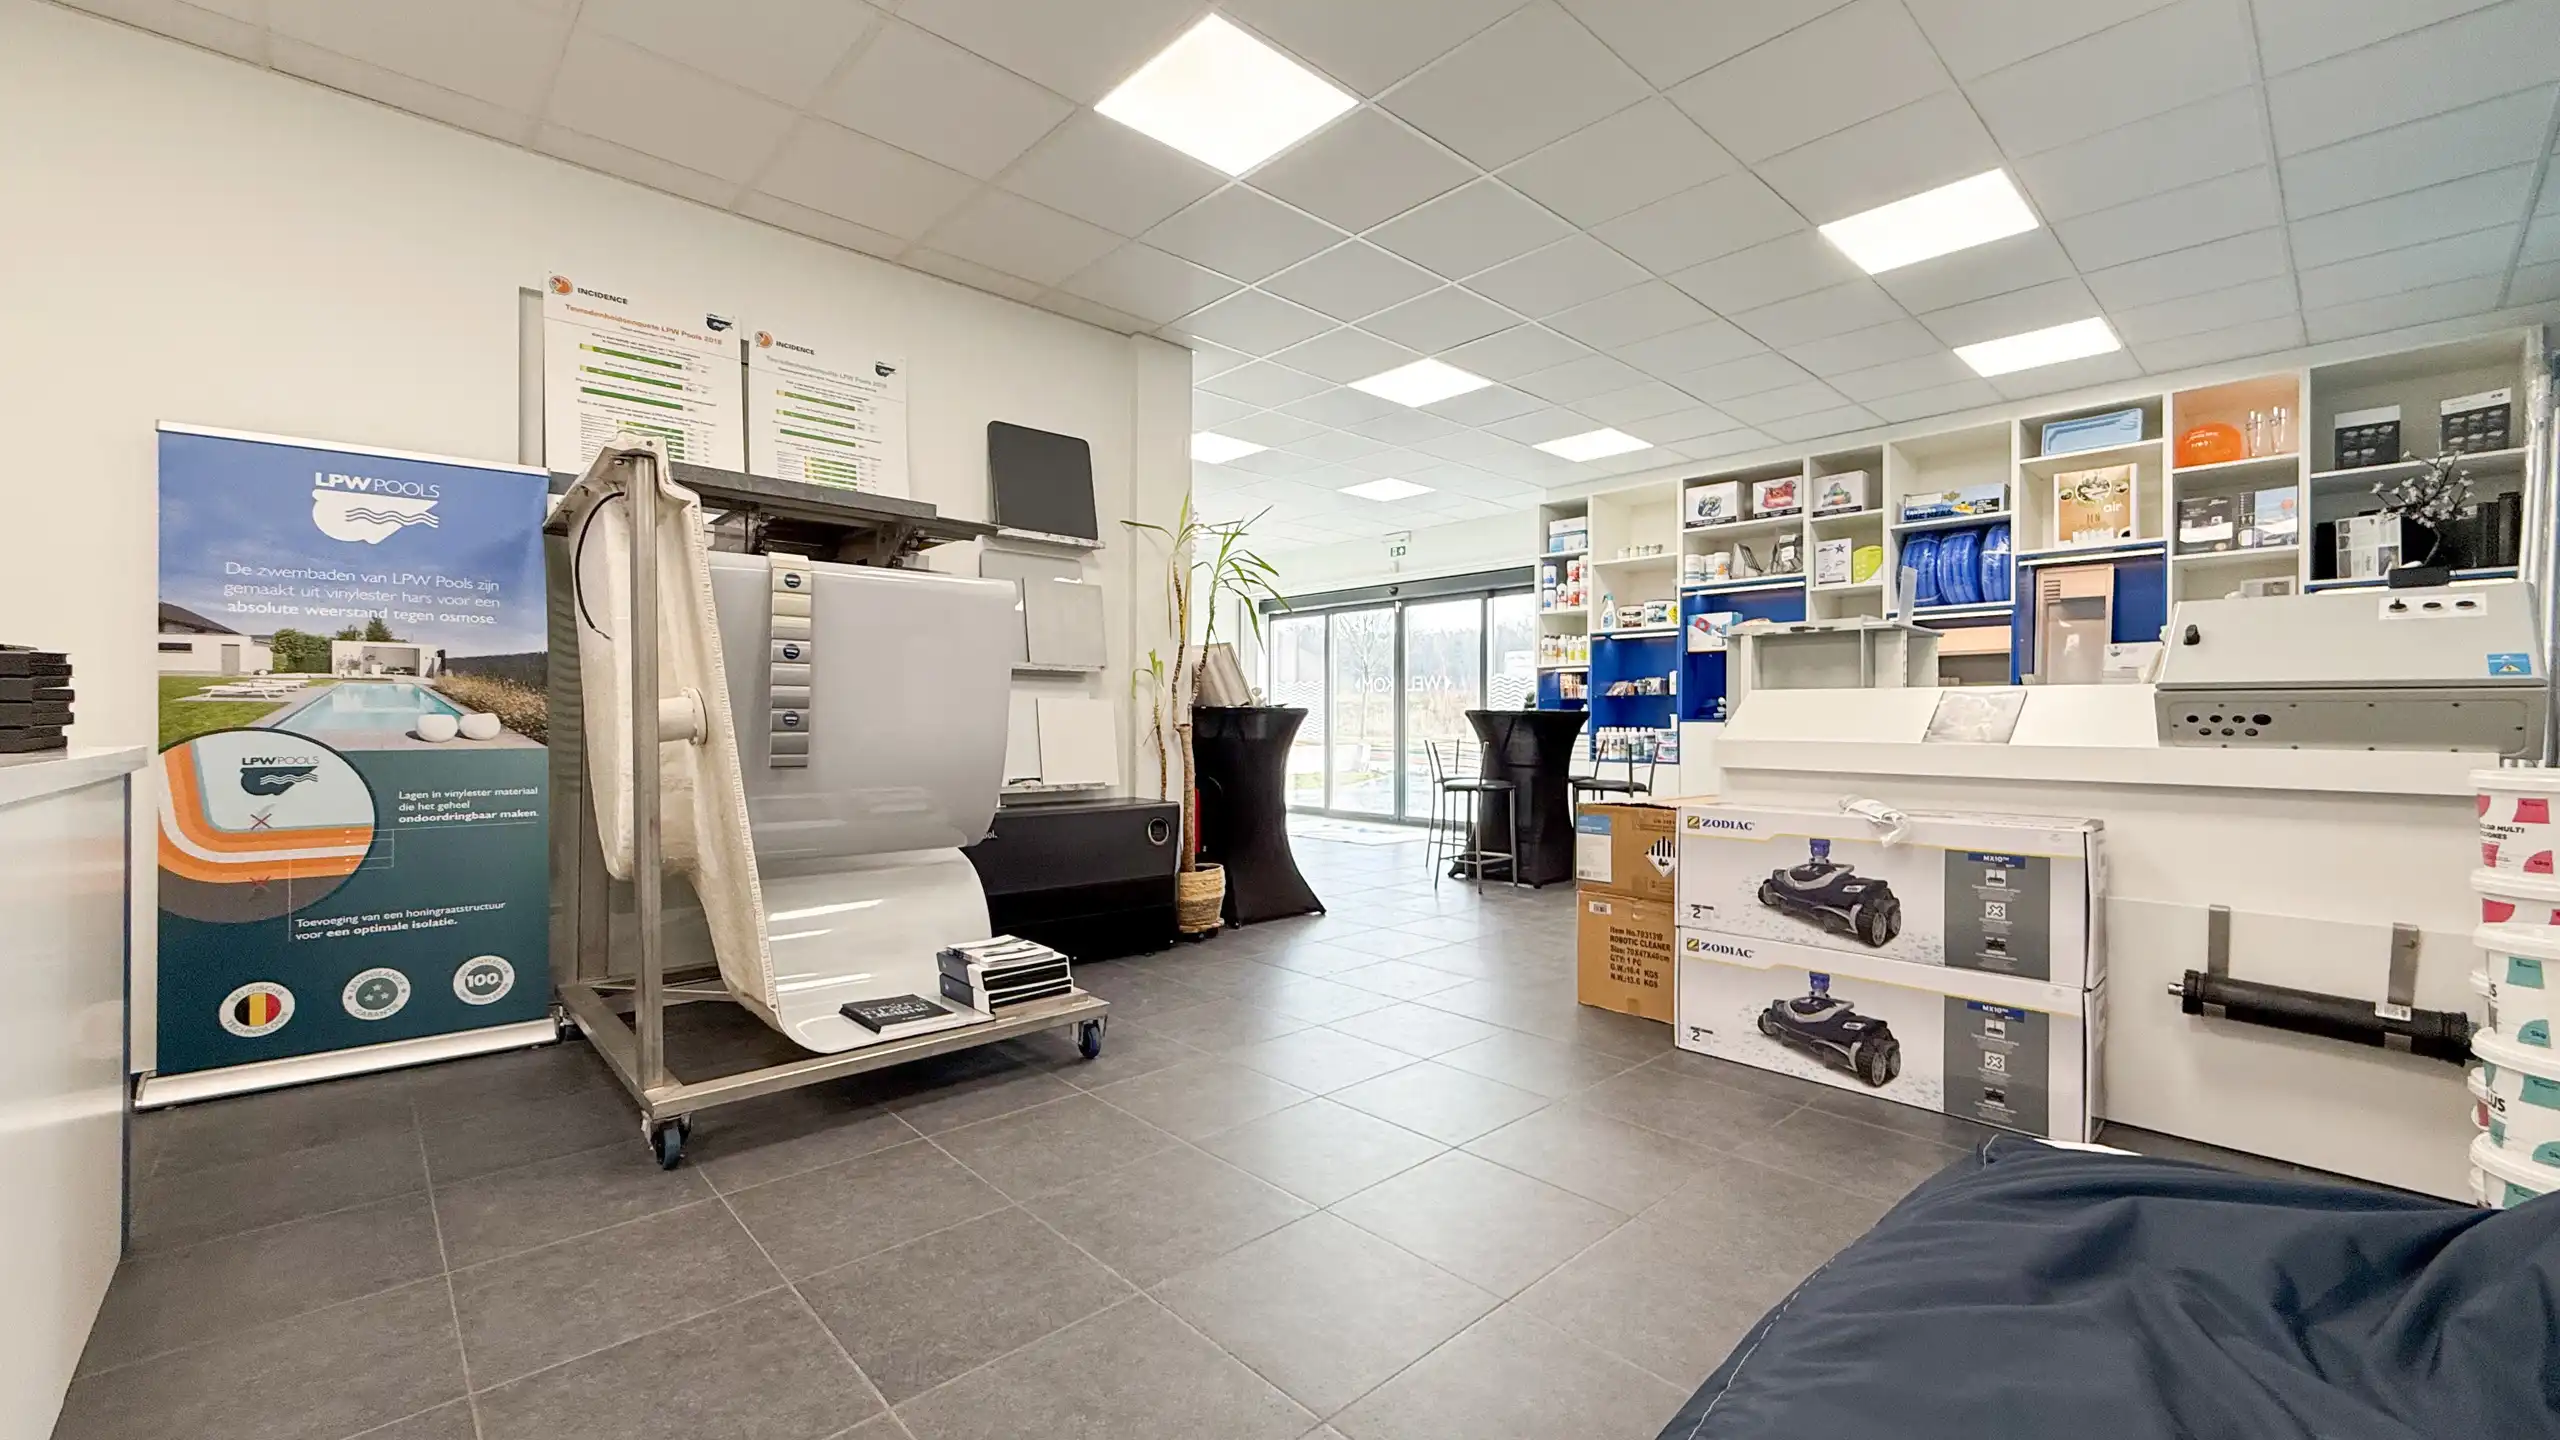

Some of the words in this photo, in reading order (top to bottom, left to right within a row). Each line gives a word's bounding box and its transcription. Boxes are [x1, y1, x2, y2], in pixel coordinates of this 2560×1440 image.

[577, 287, 628, 305] INCIDENCE
[776, 340, 815, 356] INCIDENCE
[225, 561, 252, 576] De
[257, 567, 356, 581] zwembaden
[360, 573, 387, 583] van
[392, 572, 431, 585] LPW
[436, 575, 473, 590] Pools
[477, 579, 500, 594] zijn
[223, 583, 295, 597] gemaakt
[301, 586, 320, 598] uit
[326, 588, 398, 602] vinylester
[402, 591, 432, 604] hars
[437, 596, 470, 606] voor
[475, 598, 500, 608] een
[227, 600, 299, 615] absolute
[304, 605, 388, 619] weerstand
[393, 610, 434, 624] tegen
[440, 613, 498, 625] osmose.
[398, 790, 428, 801] Lagen
[432, 790, 441, 798] in
[444, 788, 492, 800] vinylester
[494, 787, 538, 797] materiaal
[398, 802, 414, 811] die
[417, 802, 435, 811] het
[437, 801, 470, 812] geheel
[398, 811, 497, 823] ondoordringbaar
[500, 809, 539, 818] maken.
[1702, 818, 1753, 831] ZODIAC
[2497, 825, 2525, 834] MULTI
[294, 914, 359, 928] Toevoeging
[361, 913, 380, 922] van
[383, 911, 403, 920] een
[405, 902, 506, 918] honingraatstructuur
[1693, 907, 1701, 919] 2
[296, 930, 323, 940] voor
[327, 928, 350, 938] een
[353, 922, 409, 937] optimale
[412, 917, 458, 930] isolatie.
[1610, 935, 1638, 946] ROBOTIC
[1640, 940, 1671, 952] CLEANER
[1701, 942, 1753, 958] ZODIAC
[1644, 970, 1658, 979] KGS
[1644, 979, 1658, 988] KGS
[1692, 1030, 1700, 1042] 2
